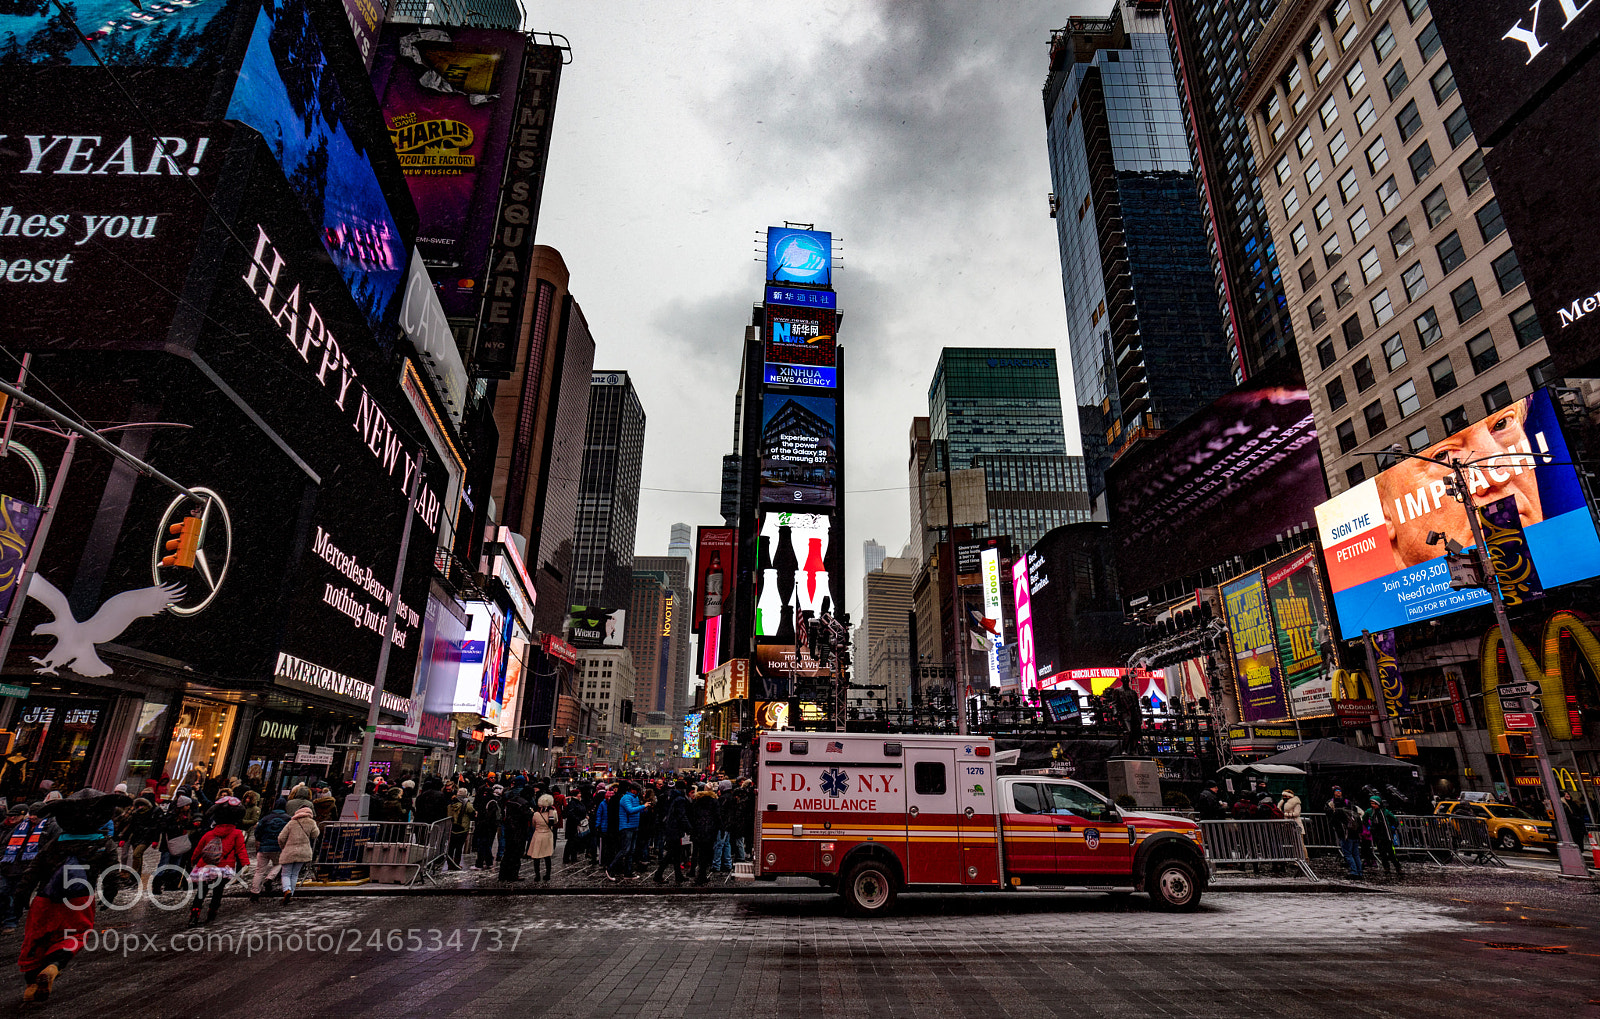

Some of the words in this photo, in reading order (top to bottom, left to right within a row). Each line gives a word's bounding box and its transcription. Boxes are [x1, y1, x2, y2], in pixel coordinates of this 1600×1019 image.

[517, 69, 551, 168] TIMES
[19, 134, 210, 176] YEAR!
[438, 155, 473, 166] FACTORY
[74, 213, 159, 245] you
[489, 182, 530, 324] SQUARE
[780, 367, 822, 379] XINHUA
[1000, 359, 1050, 368] BARCLAYS
[242, 223, 357, 412] HAPPY
[353, 385, 403, 476] NEW
[401, 452, 441, 533] YAR!
[770, 375, 795, 384] NEWS
[796, 377, 831, 386] AGENCY
[780, 433, 819, 443] Experience
[782, 441, 794, 449] the
[794, 442, 818, 451] power
[780, 455, 813, 464] Samsung
[792, 449, 817, 458] Galaxy
[1394, 431, 1553, 525] IMPACH!
[1167, 478, 1223, 516] DANIEL
[1331, 523, 1352, 540] SIGN
[1352, 513, 1371, 533] THE
[1336, 536, 1377, 563] PETITION
[312, 526, 385, 602] Mercedes-Benz
[407, 608, 420, 629] you
[988, 559, 998, 594] 10,000
[1382, 578, 1401, 593] Join
[1402, 562, 1447, 587] 3,969,300
[323, 583, 364, 628] nothing
[363, 603, 380, 632] but
[391, 622, 407, 648] best
[663, 595, 673, 637] NOVOTEL
[1226, 598, 1244, 617] NOT
[1243, 588, 1265, 610] JUST
[1276, 596, 1314, 630] BRONX
[1408, 604, 1423, 616] PAID
[1424, 602, 1438, 612] FOR
[1439, 598, 1448, 609] BY
[1449, 594, 1465, 606] TOM
[1230, 615, 1239, 633] A
[1238, 604, 1269, 631] SIMPLE
[1233, 626, 1272, 654] SPONGE
[1286, 625, 1317, 662] TALE
[278, 657, 343, 695] AMERICAN
[768, 661, 788, 669] HOPE
[1071, 668, 1100, 678] CHOCOLATE
[1100, 667, 1120, 677] WORLD
[260, 720, 299, 741] DRINK
[770, 772, 811, 792] F.D.
[857, 774, 898, 793] N.Y.
[966, 767, 985, 775] 1276
[793, 798, 877, 811] AMBULANCE
